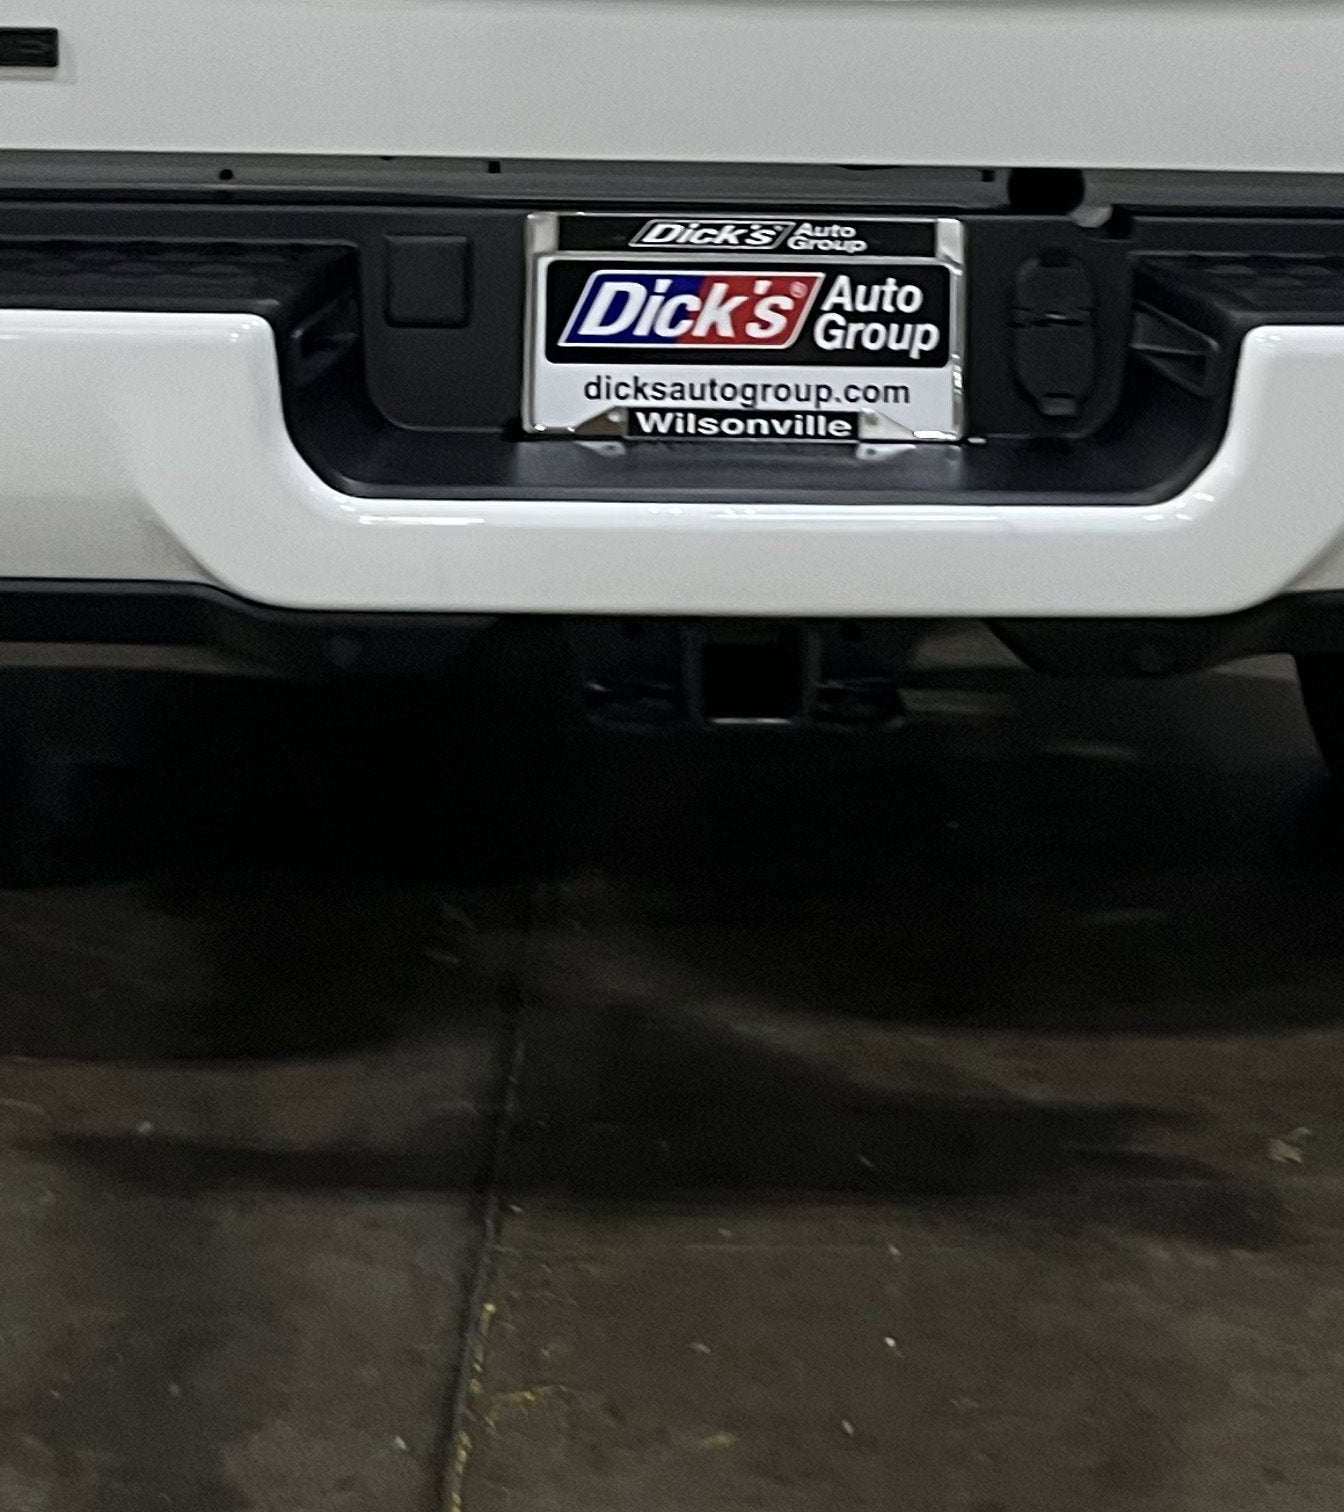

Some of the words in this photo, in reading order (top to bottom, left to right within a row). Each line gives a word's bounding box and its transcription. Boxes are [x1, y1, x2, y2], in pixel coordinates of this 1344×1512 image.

[641, 222, 777, 245] Dick's
[794, 222, 856, 238] Auto
[787, 236, 868, 254] Group
[578, 278, 794, 338] Dick's
[821, 274, 924, 314] Auto
[812, 312, 941, 360] Group
[584, 375, 911, 409] dicksautogroup.com
[635, 410, 853, 437] Wilsonville
